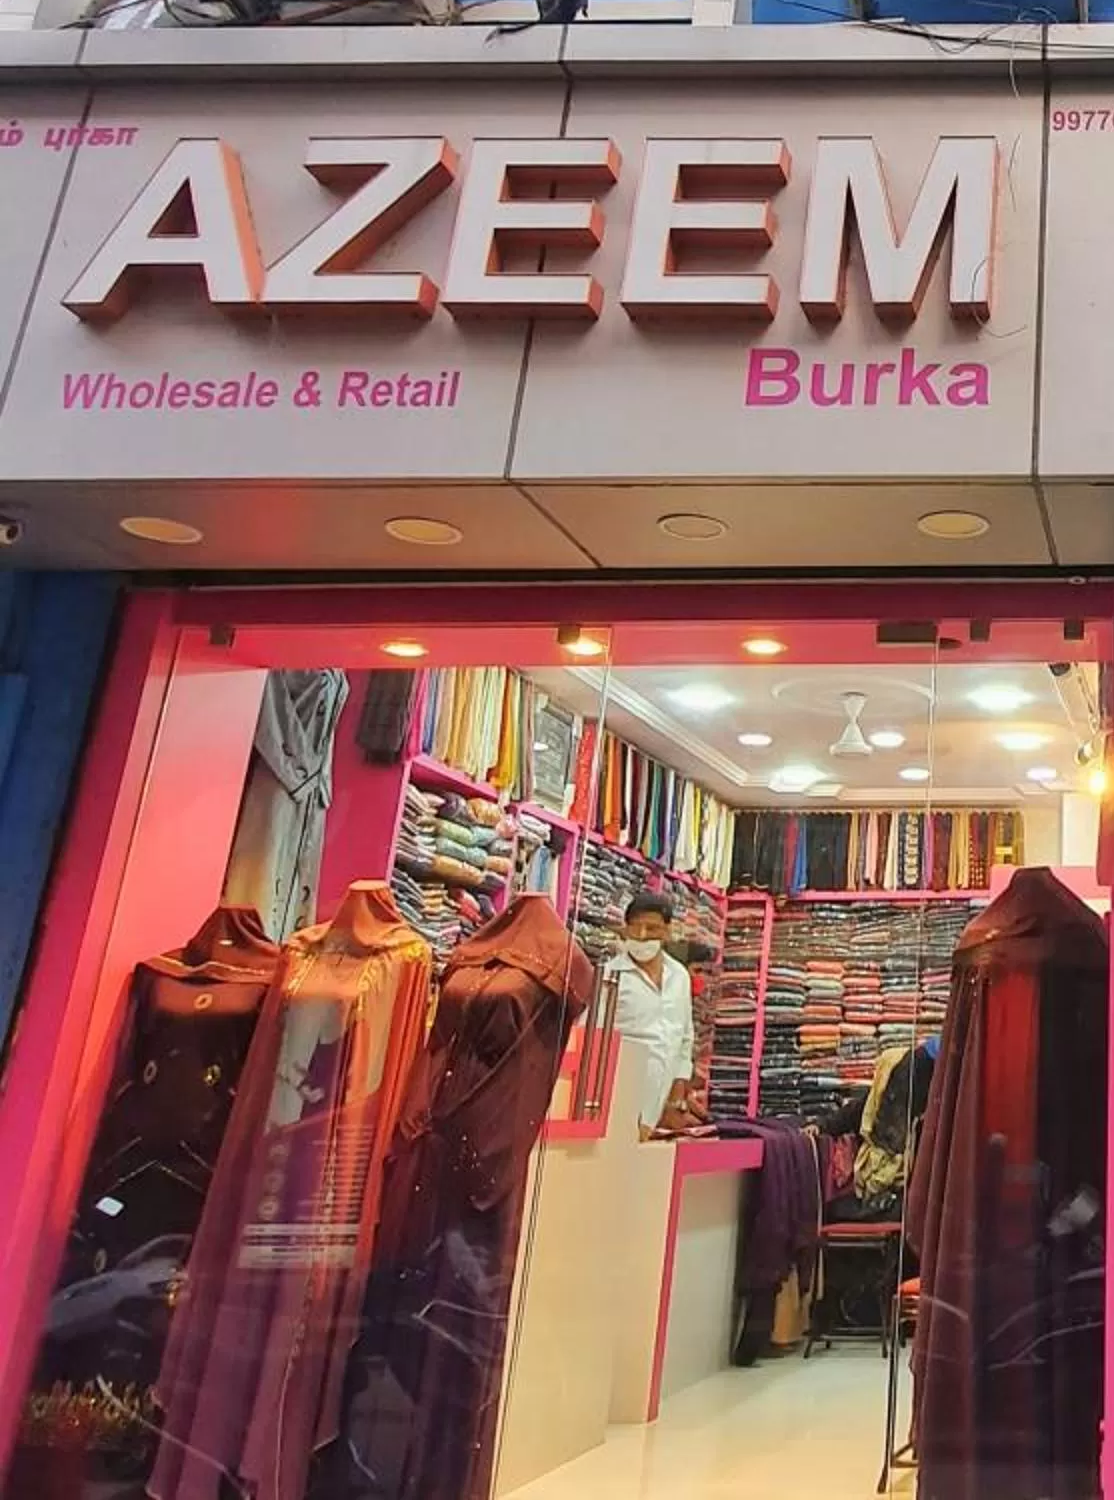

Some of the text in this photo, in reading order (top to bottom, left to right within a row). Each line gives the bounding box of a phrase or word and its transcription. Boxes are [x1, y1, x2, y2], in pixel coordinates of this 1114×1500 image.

[61, 136, 999, 318] AZEEM
[62, 371, 461, 409] Wholesale & Retail
[745, 348, 990, 406] Burka
